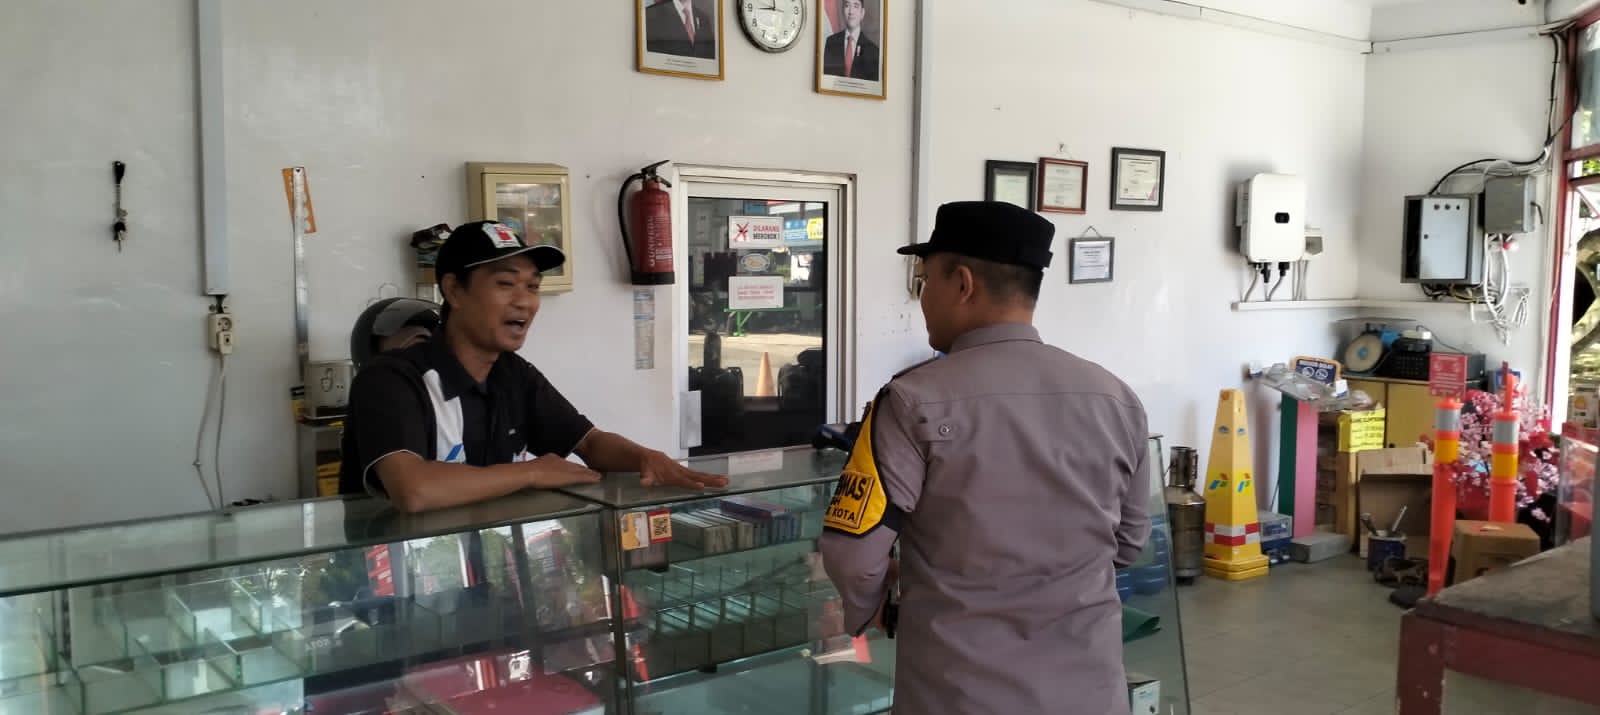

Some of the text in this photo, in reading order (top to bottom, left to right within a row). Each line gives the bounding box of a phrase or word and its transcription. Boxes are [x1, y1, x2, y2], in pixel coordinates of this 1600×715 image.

[793, 6, 800, 15] 3
[752, 18, 758, 27] 8
[831, 509, 855, 521] KOTA
